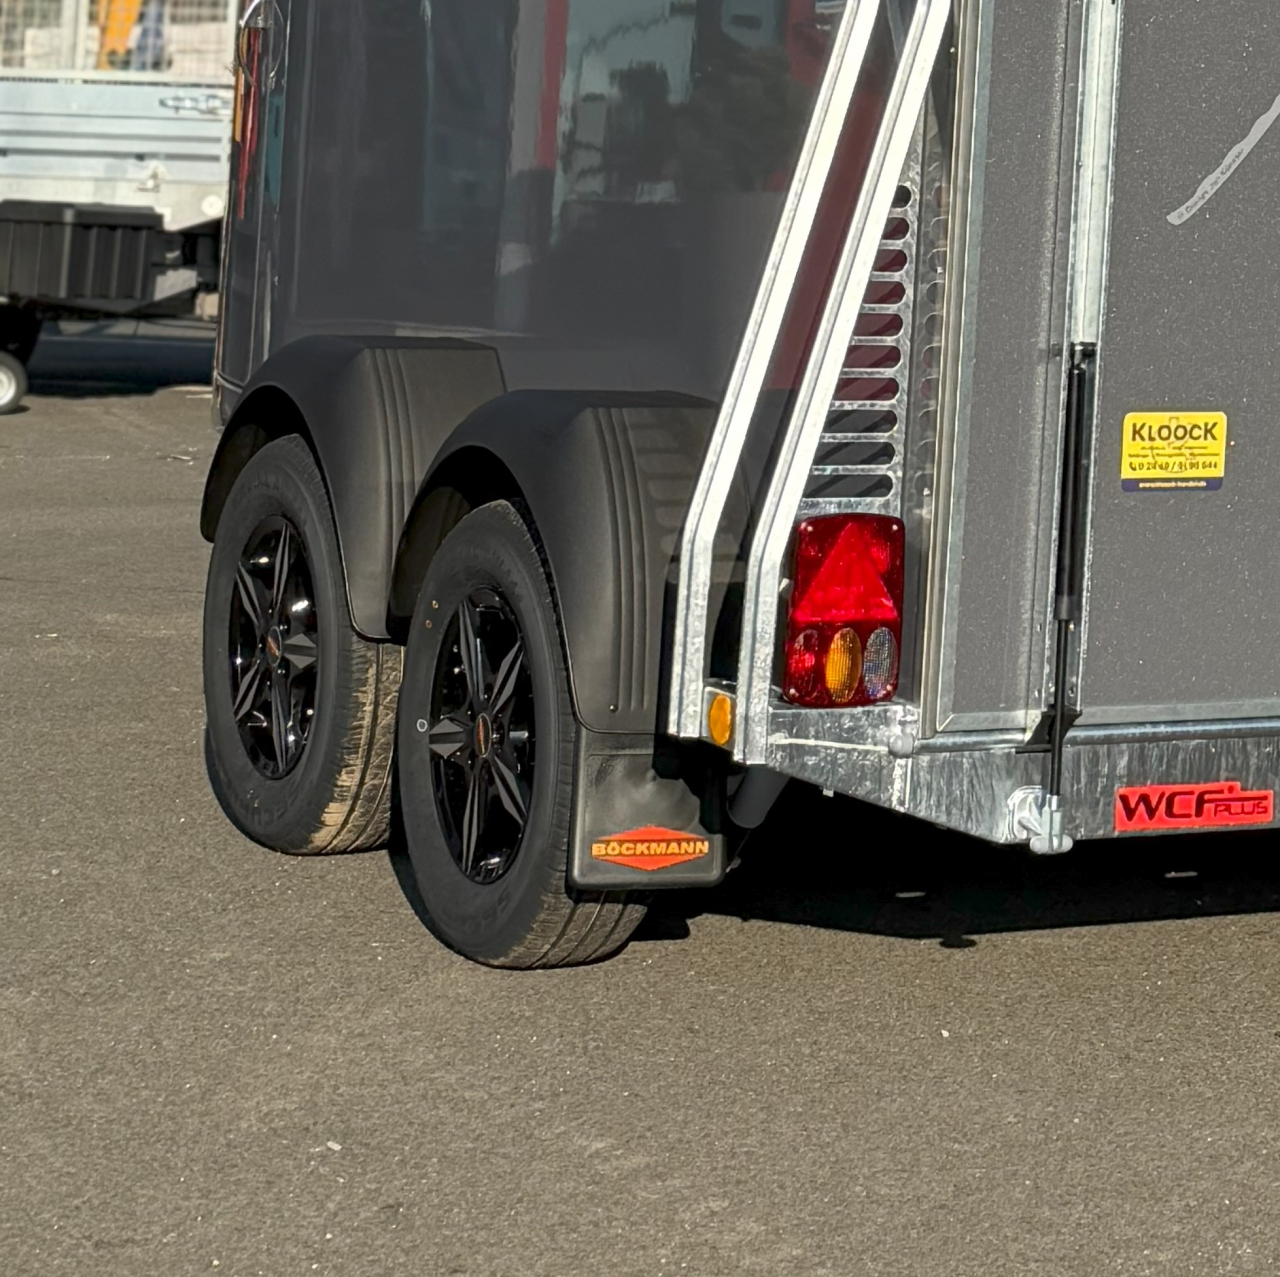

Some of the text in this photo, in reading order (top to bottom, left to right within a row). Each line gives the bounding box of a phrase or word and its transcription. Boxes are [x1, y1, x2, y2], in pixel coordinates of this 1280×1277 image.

[1131, 422, 1219, 442] KLOOCK
[1119, 788, 1268, 822] WCF PLUS
[591, 840, 709, 856] BÖCKMANN
